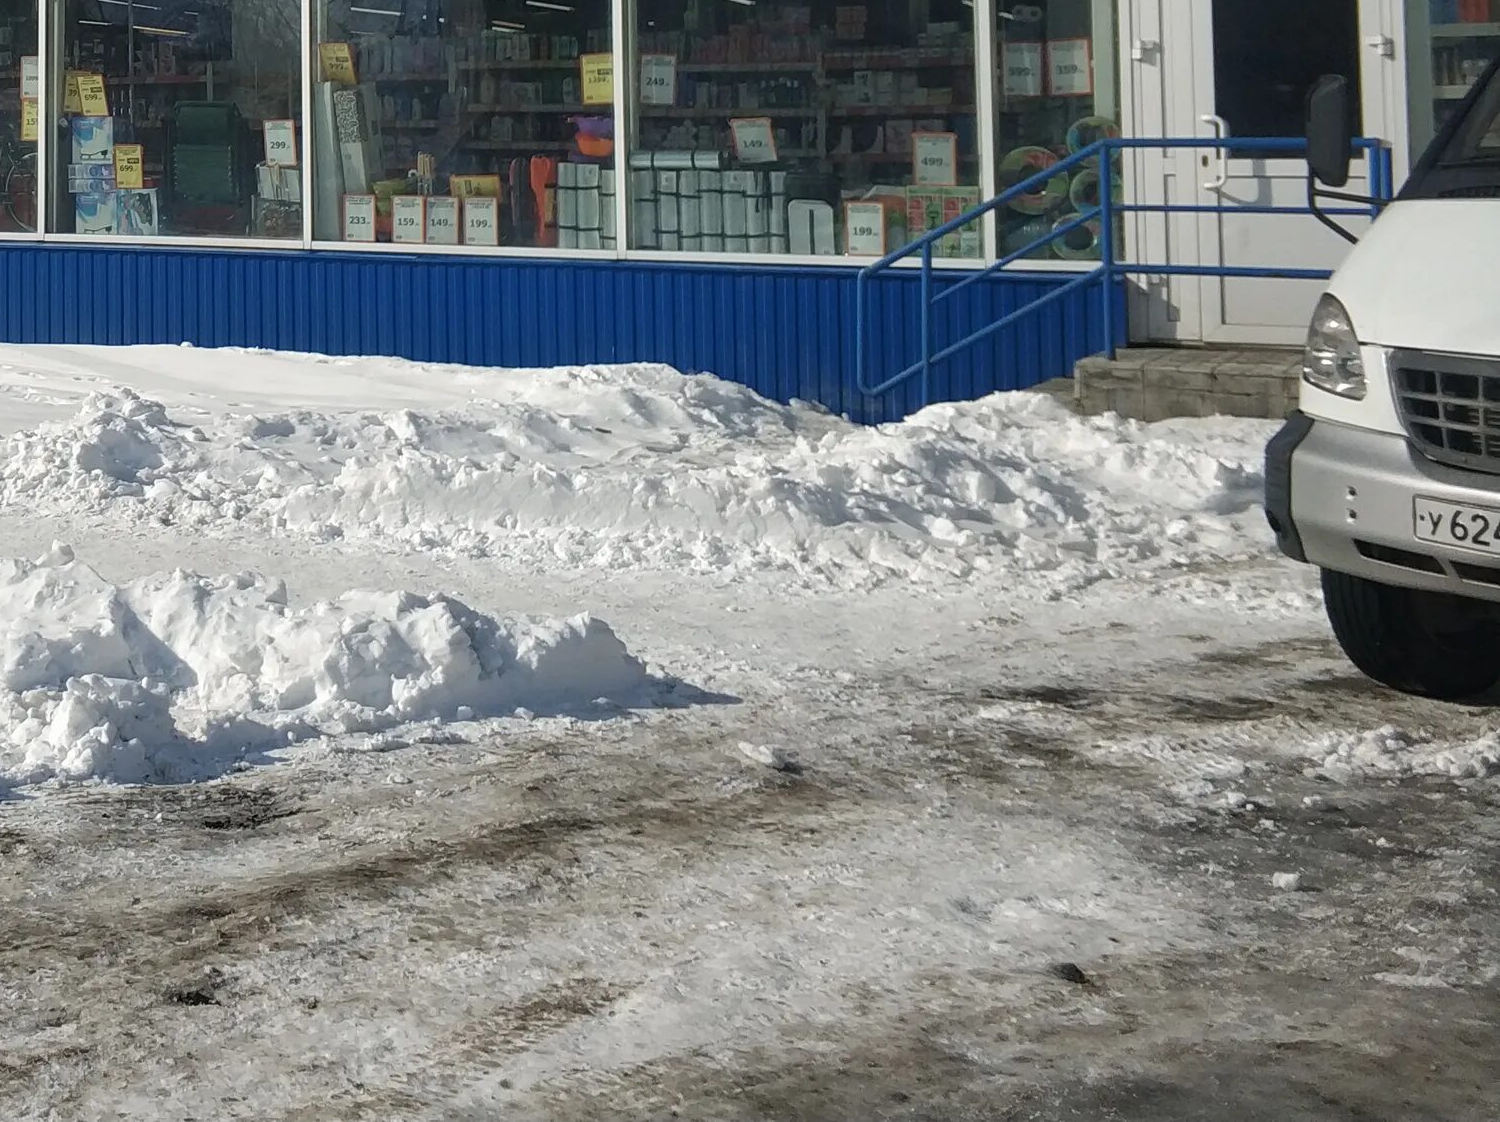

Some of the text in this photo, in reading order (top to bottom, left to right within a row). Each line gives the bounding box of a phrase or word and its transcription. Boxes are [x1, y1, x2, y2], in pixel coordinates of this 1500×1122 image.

[270, 141, 286, 149] 299
[120, 164, 134, 172] 699
[350, 216, 367, 225] 233
[397, 217, 415, 226] 159
[431, 218, 449, 227] 149
[470, 219, 488, 228] 199
[853, 227, 873, 236] 199
